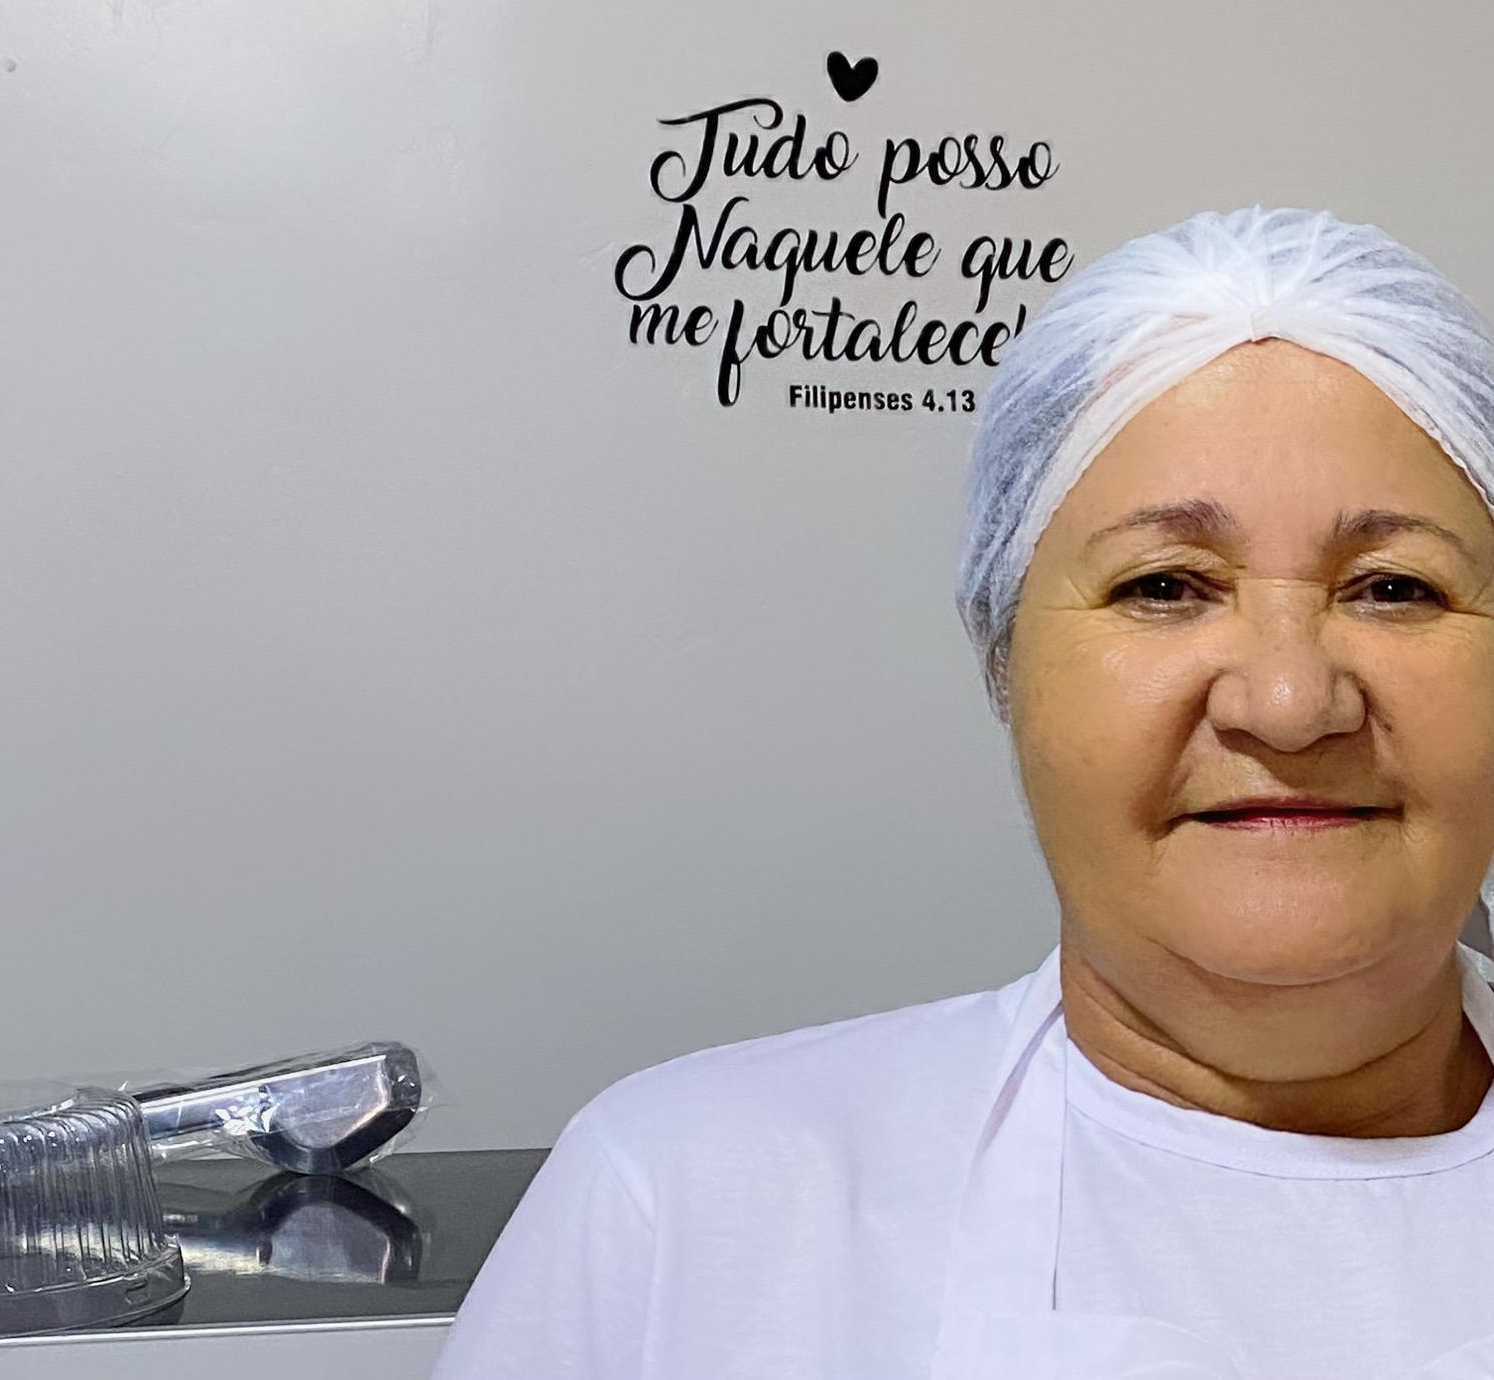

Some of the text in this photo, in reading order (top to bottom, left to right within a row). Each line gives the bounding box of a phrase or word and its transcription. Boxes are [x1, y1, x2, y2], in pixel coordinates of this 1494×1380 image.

[650, 98, 1060, 219] Tudo posso
[615, 196, 1075, 314] Naquele que
[629, 301, 719, 346] me
[789, 384, 976, 414] Filipenses 4.13
